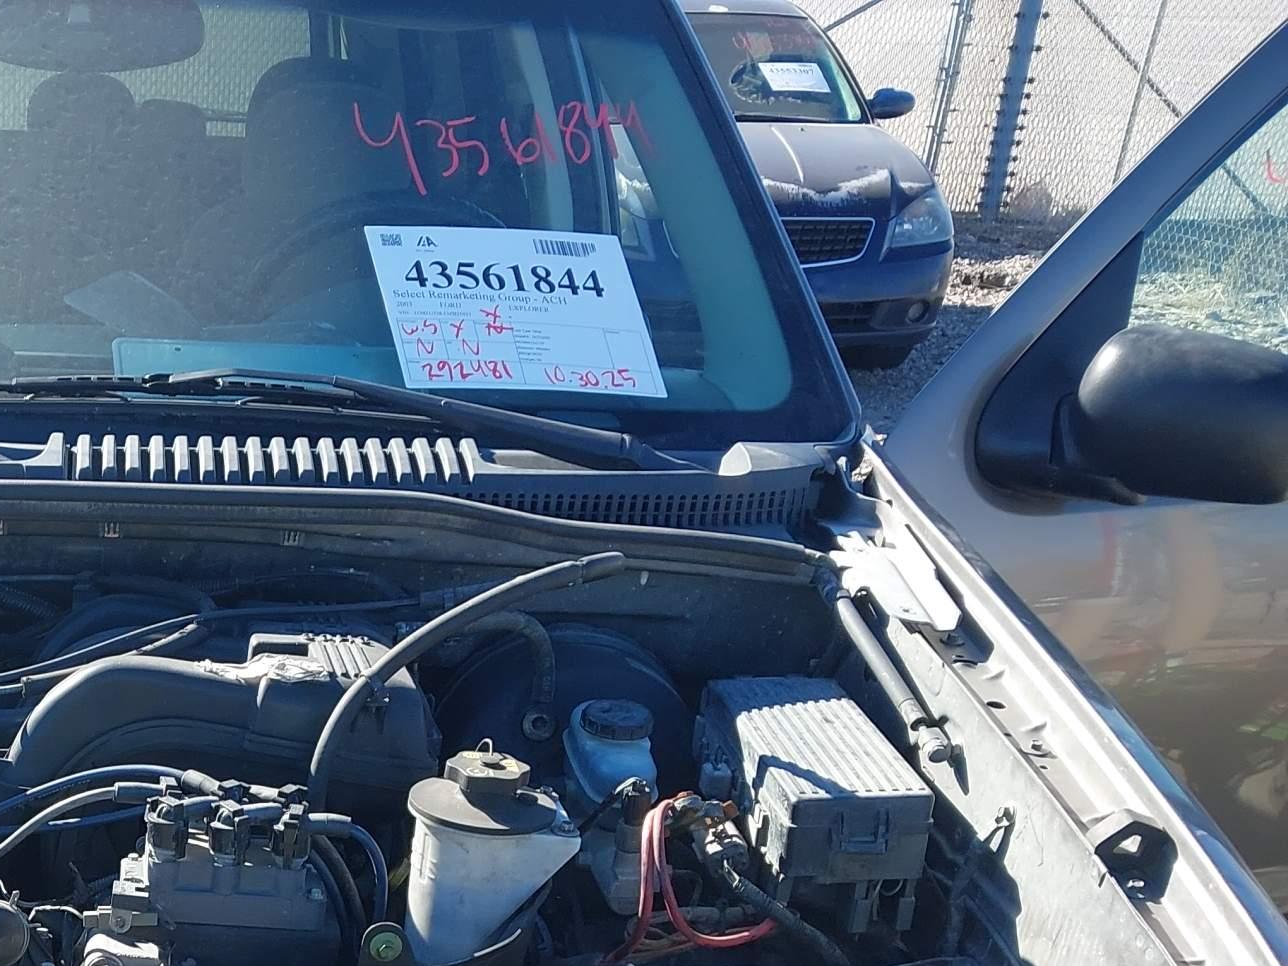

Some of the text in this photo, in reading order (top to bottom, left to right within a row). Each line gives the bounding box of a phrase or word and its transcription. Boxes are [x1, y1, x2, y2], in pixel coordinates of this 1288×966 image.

[353, 100, 656, 196] 43561844
[404, 260, 605, 297] 43561844
[393, 290, 426, 299] Select
[429, 290, 496, 303] Remarketing
[498, 293, 532, 305] Group
[509, 305, 550, 313] EXPLORER
[462, 338, 481, 356] N
[421, 360, 513, 381] 292481
